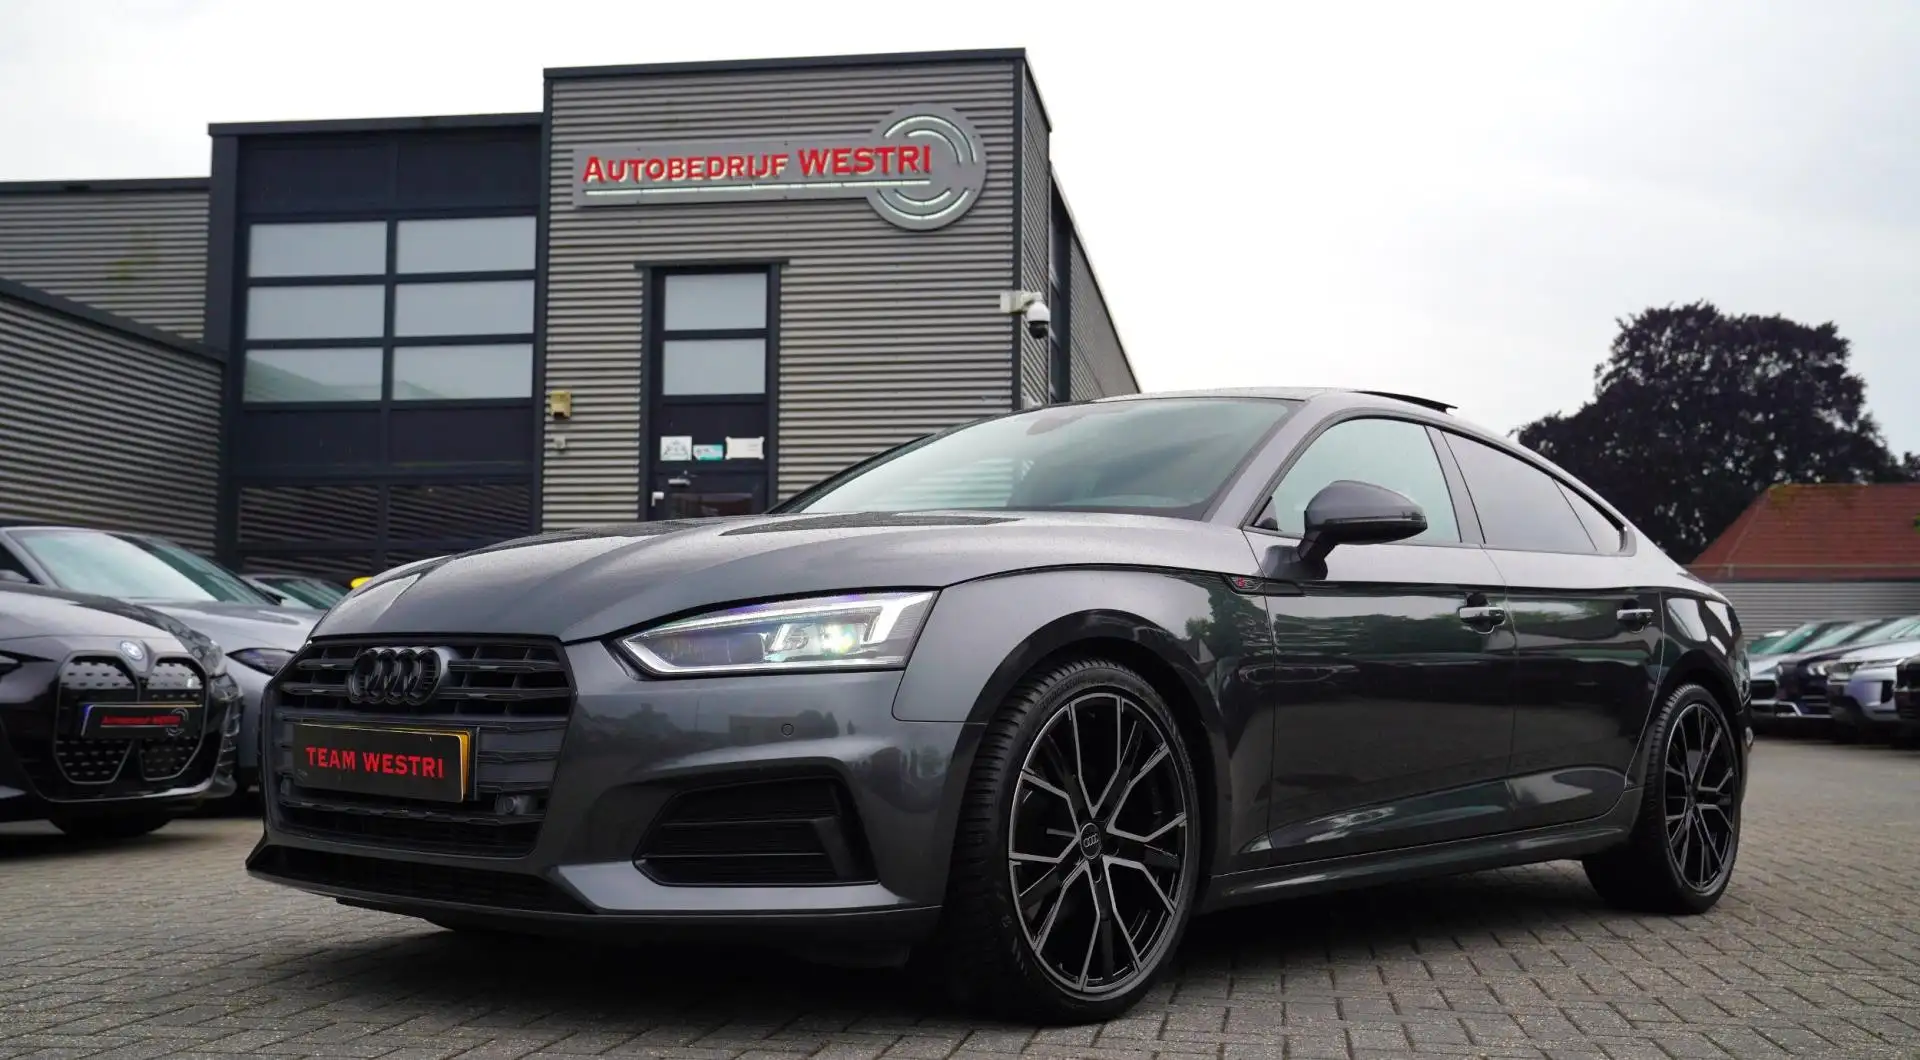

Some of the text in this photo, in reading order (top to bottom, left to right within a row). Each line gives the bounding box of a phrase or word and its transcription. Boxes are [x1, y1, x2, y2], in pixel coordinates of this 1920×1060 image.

[583, 144, 932, 183] AUTOBEDRIJF WESTRI
[305, 746, 444, 778] TEAM WESTRI
